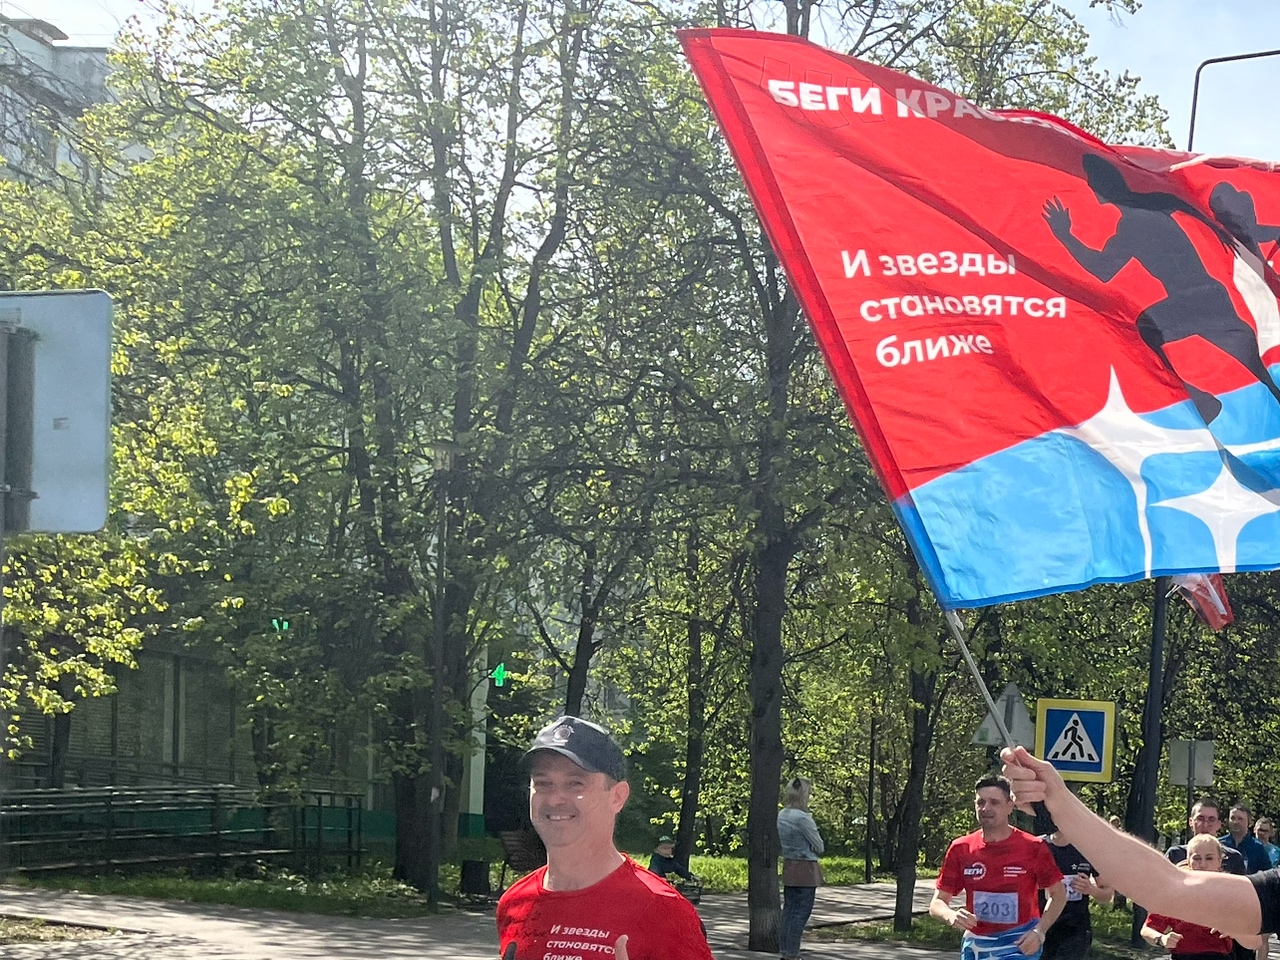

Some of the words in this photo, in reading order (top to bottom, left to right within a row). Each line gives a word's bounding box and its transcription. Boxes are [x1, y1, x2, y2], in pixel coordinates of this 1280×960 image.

[768, 79, 882, 116] БЕГИ
[841, 249, 871, 278] И
[878, 250, 1016, 277] звезды
[859, 293, 1067, 322] становятся
[875, 334, 994, 368] ближе
[980, 901, 1010, 917] 203
[550, 924, 561, 935] И
[562, 926, 610, 939] звезды
